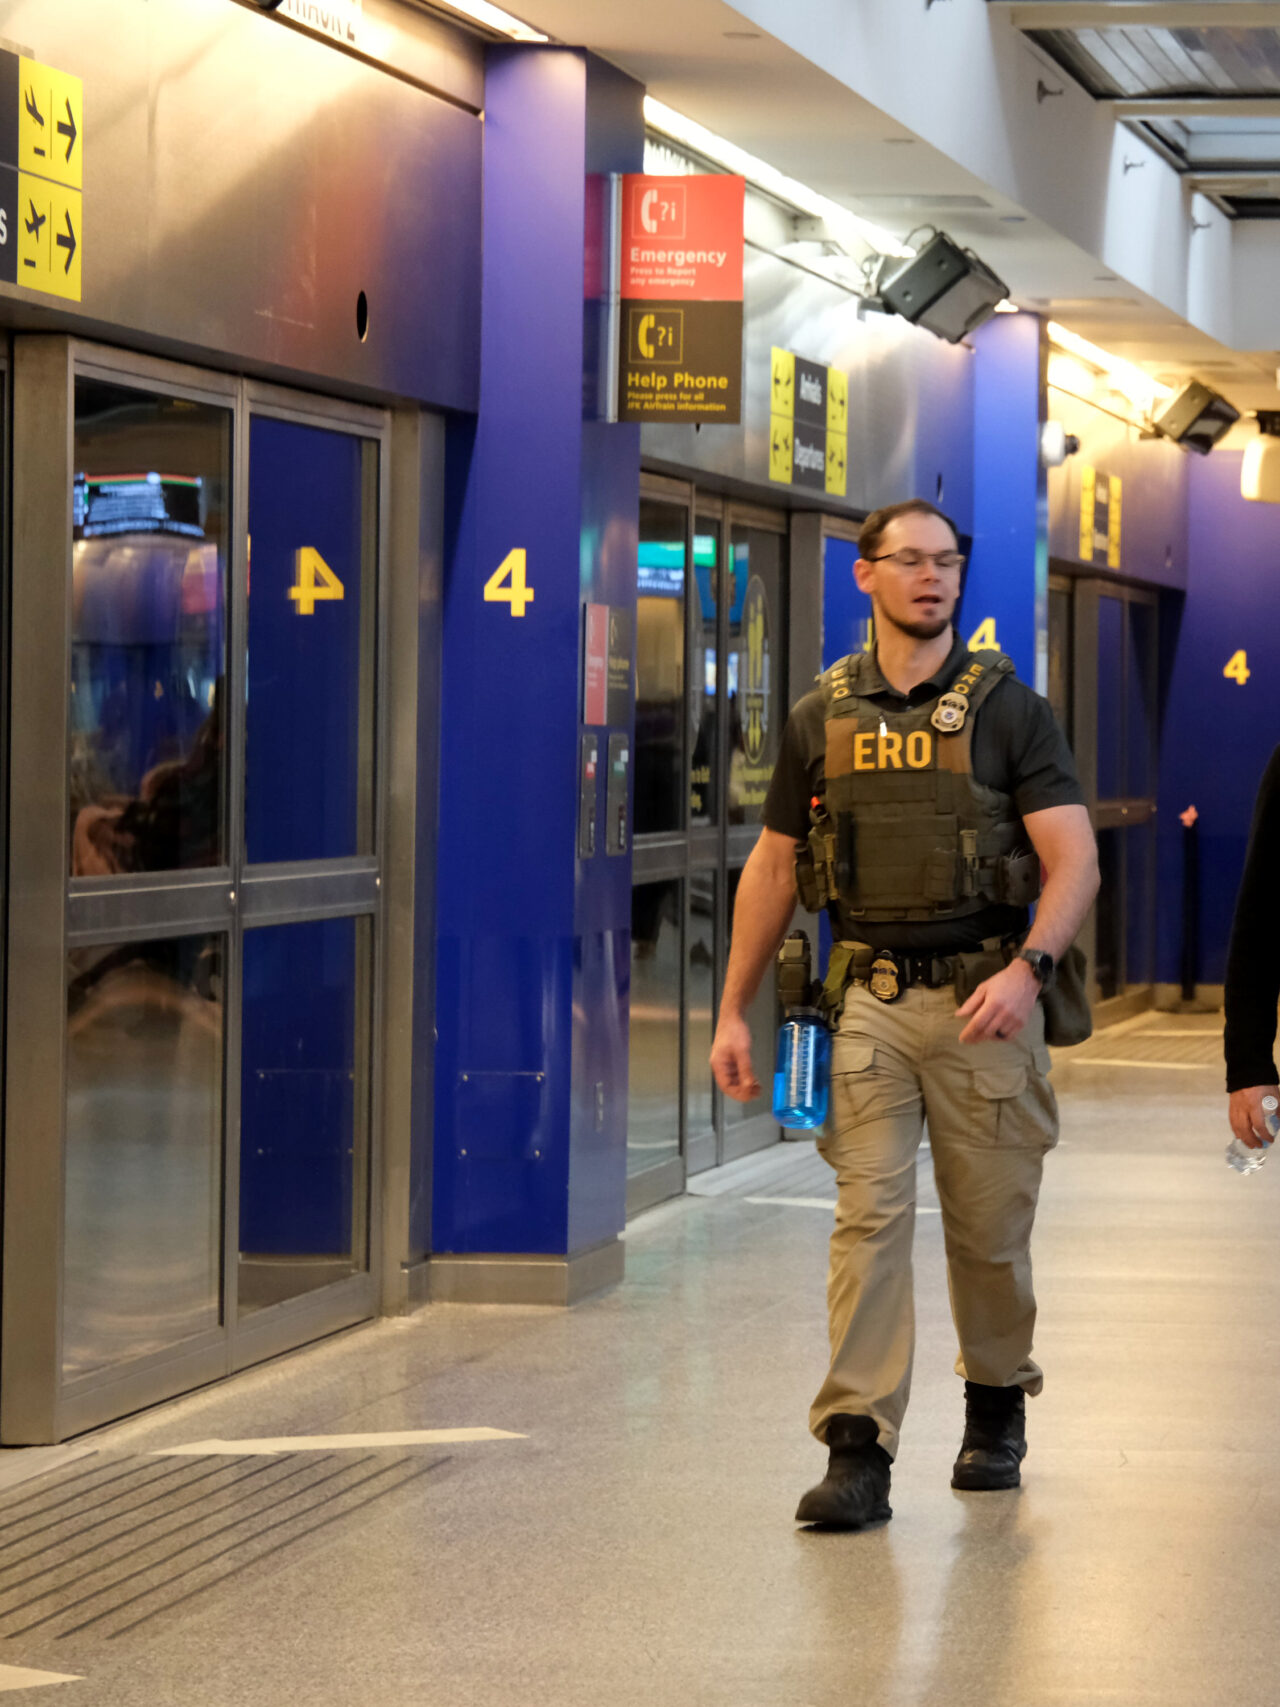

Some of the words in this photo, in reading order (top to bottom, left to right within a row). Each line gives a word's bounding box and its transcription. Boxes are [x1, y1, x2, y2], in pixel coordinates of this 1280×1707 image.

[630, 247, 727, 268] Emergency
[655, 267, 665, 275] to
[667, 267, 696, 277] Report
[627, 371, 667, 391] Help
[673, 371, 728, 389] Phone
[484, 548, 534, 617] 4
[967, 617, 1001, 652] 4
[953, 663, 985, 694] ERO
[1224, 649, 1250, 685] 4
[831, 668, 849, 699] ERO
[854, 730, 932, 770] ERO
